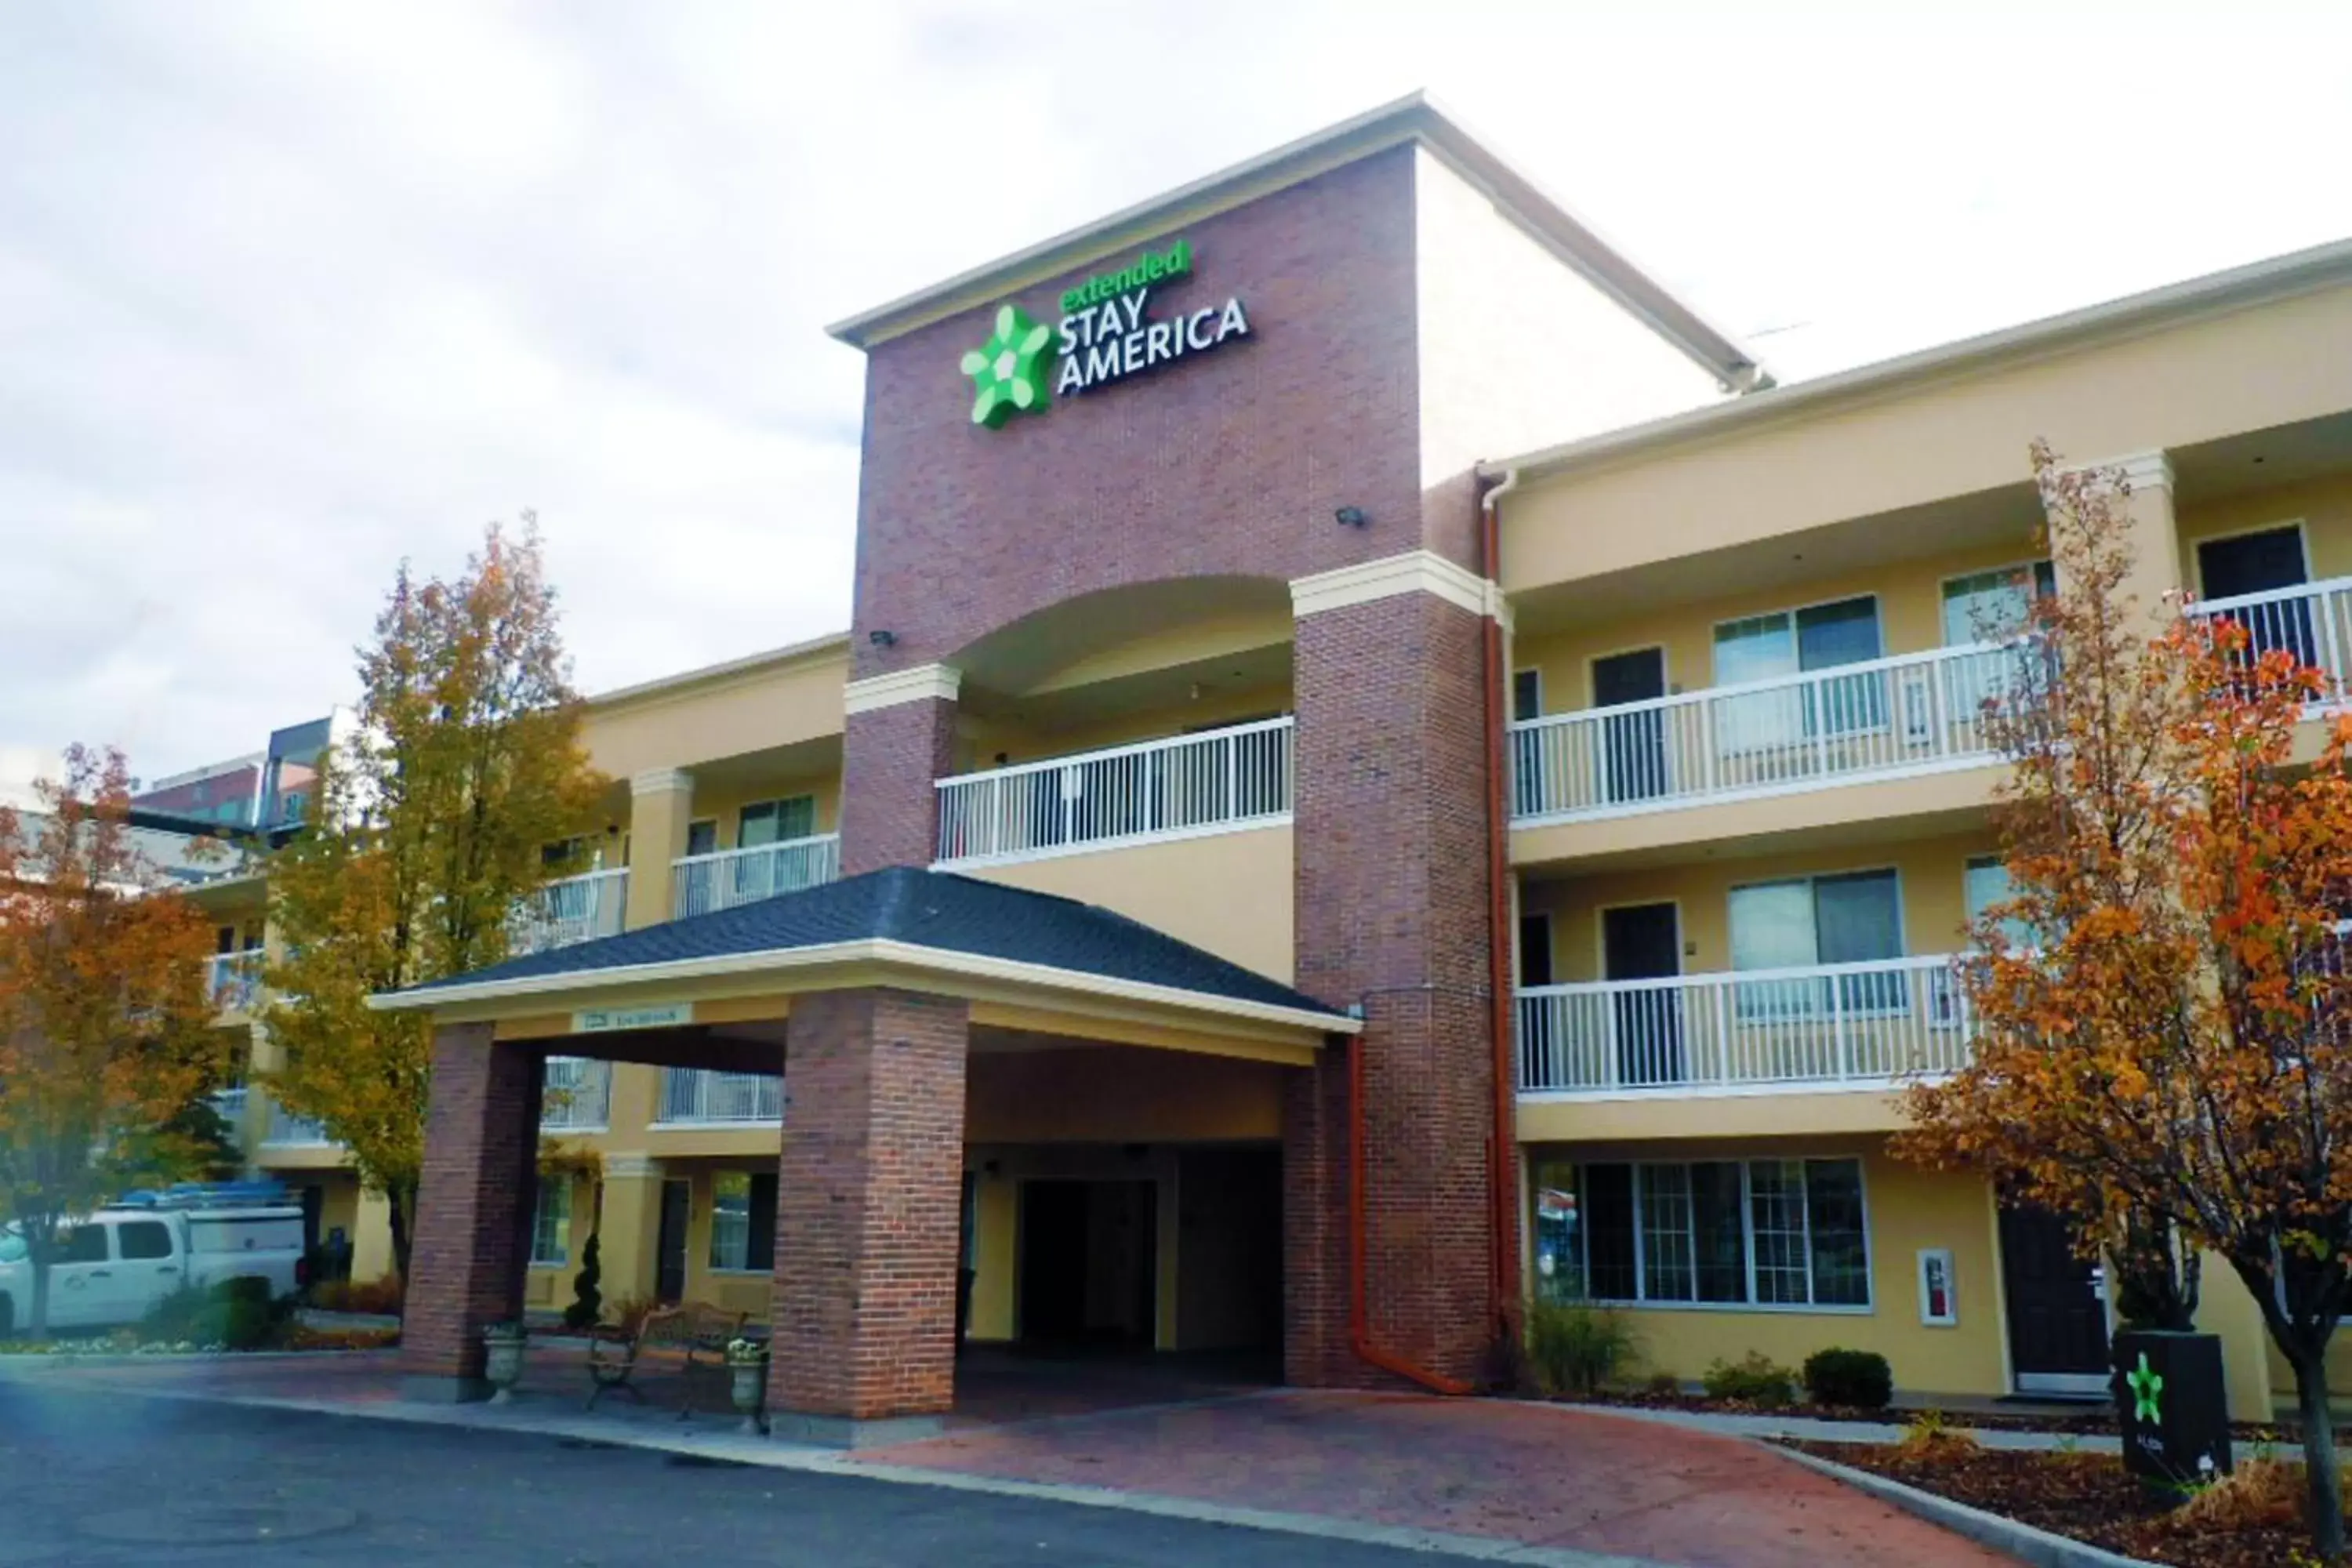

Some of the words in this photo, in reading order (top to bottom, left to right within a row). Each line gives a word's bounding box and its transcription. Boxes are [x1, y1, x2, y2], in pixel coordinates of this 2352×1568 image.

[1061, 240, 1189, 311] extended
[1057, 298, 1249, 395] AMERICA
[1058, 288, 1148, 355] STAY
